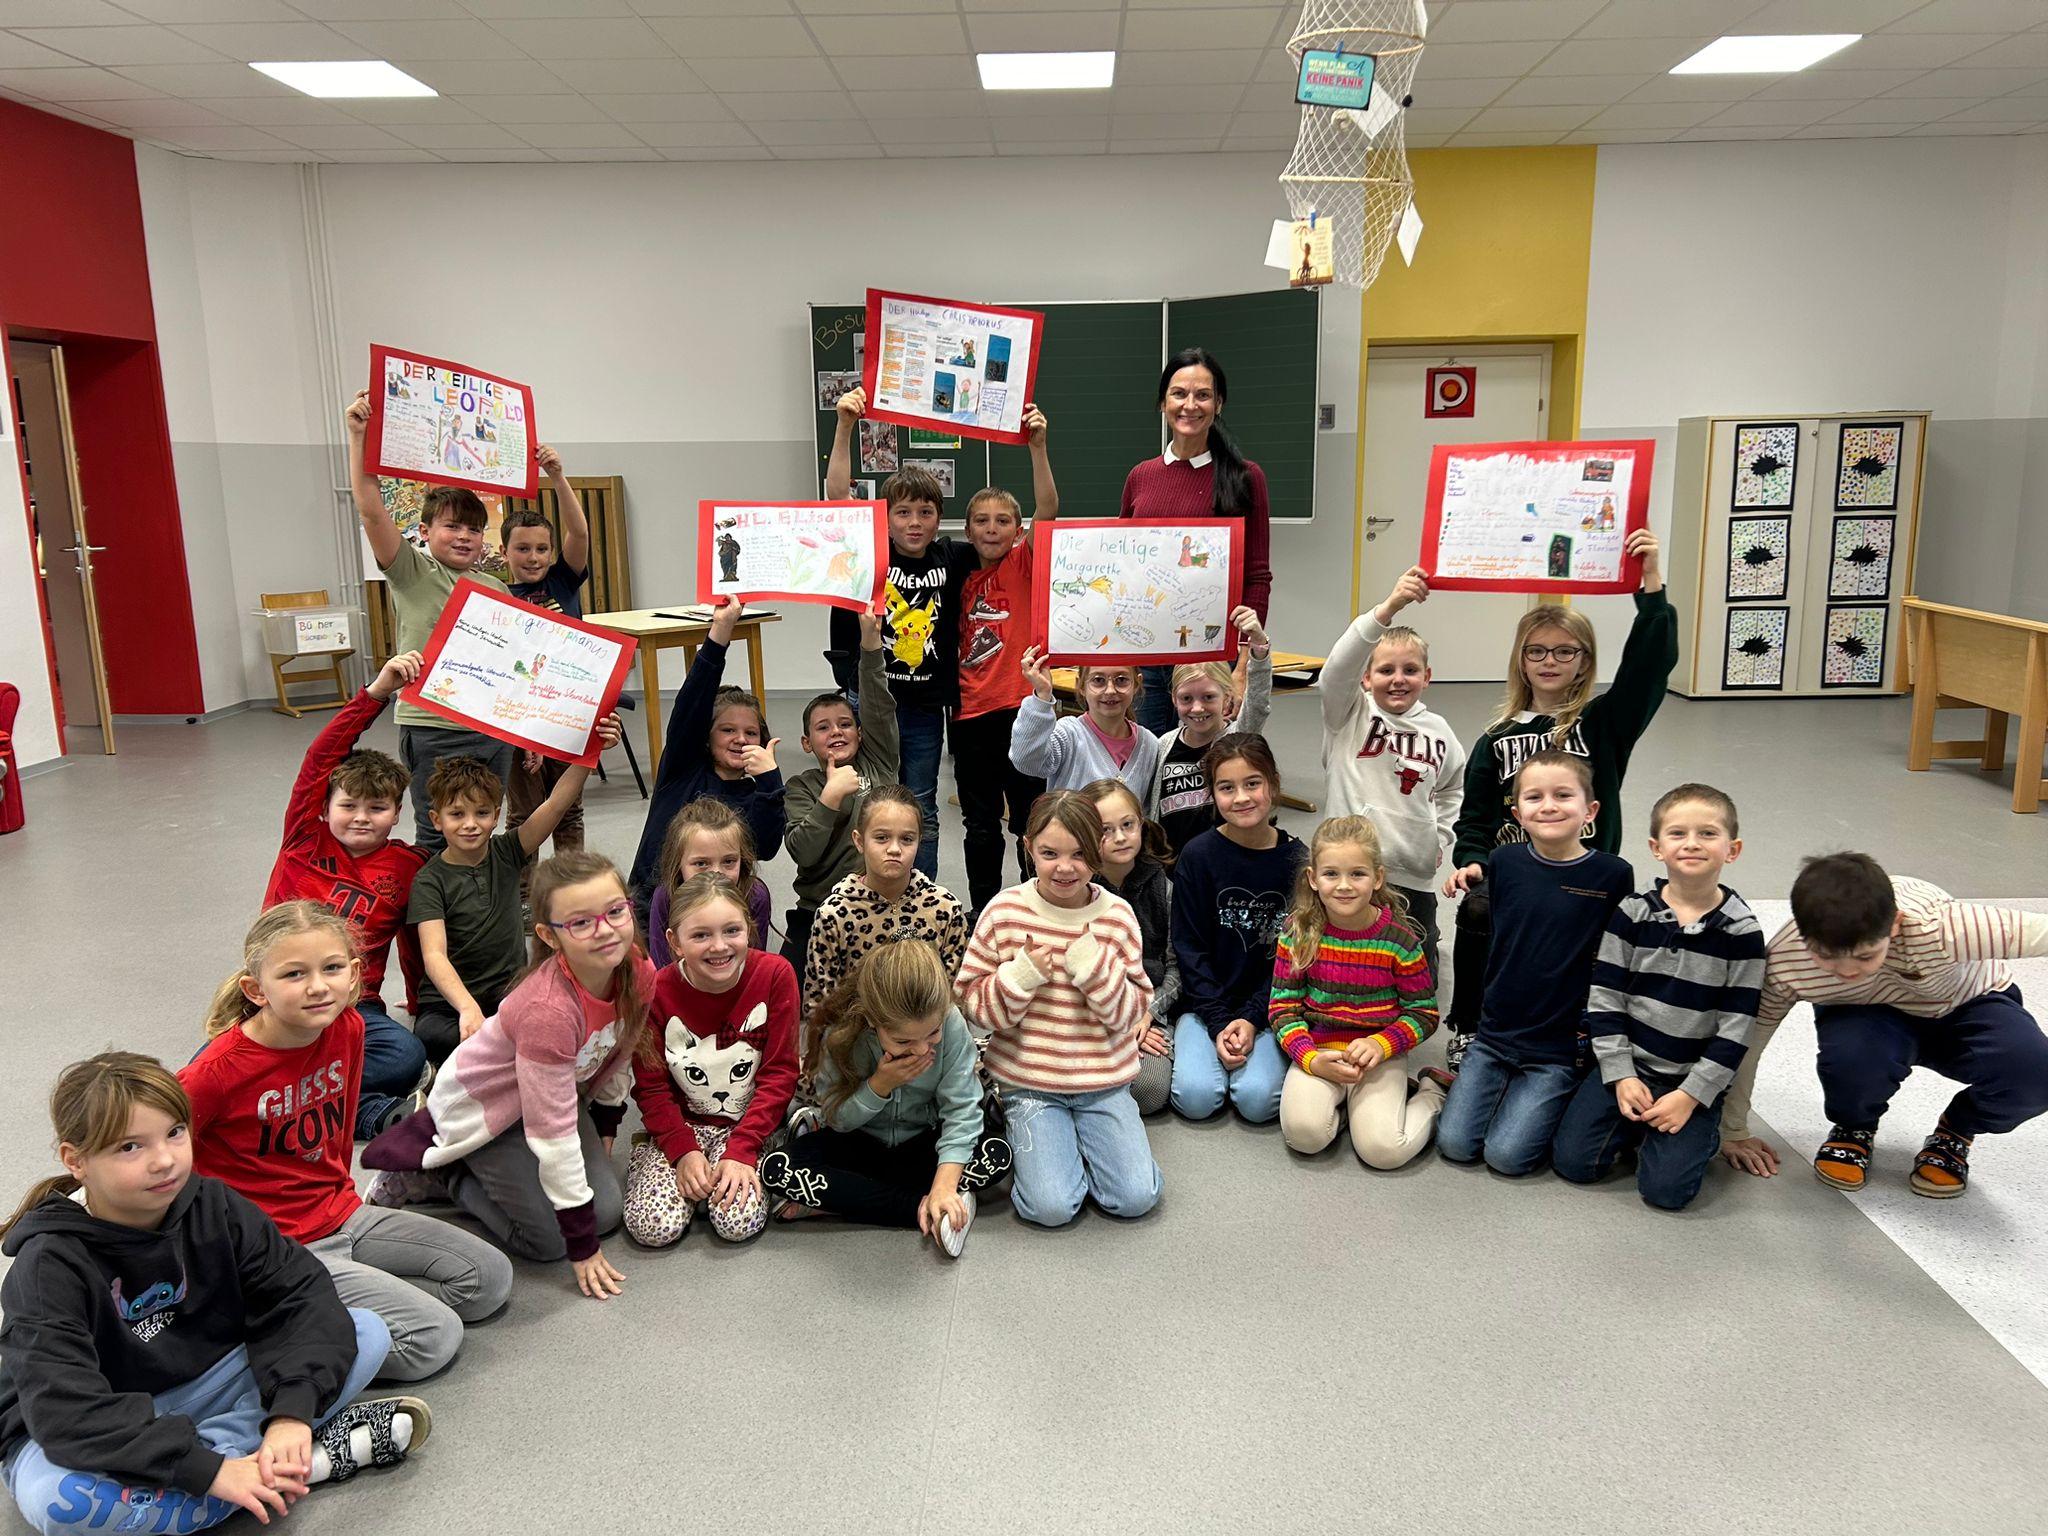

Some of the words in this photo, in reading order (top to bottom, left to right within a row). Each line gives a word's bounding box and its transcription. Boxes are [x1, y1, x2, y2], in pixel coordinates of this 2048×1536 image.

[1306, 71, 1335, 87] KEINE
[1335, 75, 1365, 90] PANIK
[888, 303, 906, 315] DER
[814, 313, 866, 350] Besu
[403, 361, 437, 381] DER
[433, 386, 523, 422] LEOPOLD
[1060, 533, 1084, 551] Die
[1099, 533, 1159, 564] heilige
[1054, 555, 1121, 575] Margarethe
[1356, 716, 1447, 778] BULLS
[1166, 775, 1205, 793] #AND
[1227, 897, 1247, 907] but
[257, 1059, 345, 1120] GUESS
[257, 1095, 345, 1157] ICON
[131, 1317, 151, 1336] CUTE
[152, 1311, 176, 1323] BUT
[139, 1317, 174, 1342] CHEEKY
[47, 1472, 234, 1534] STTCH
